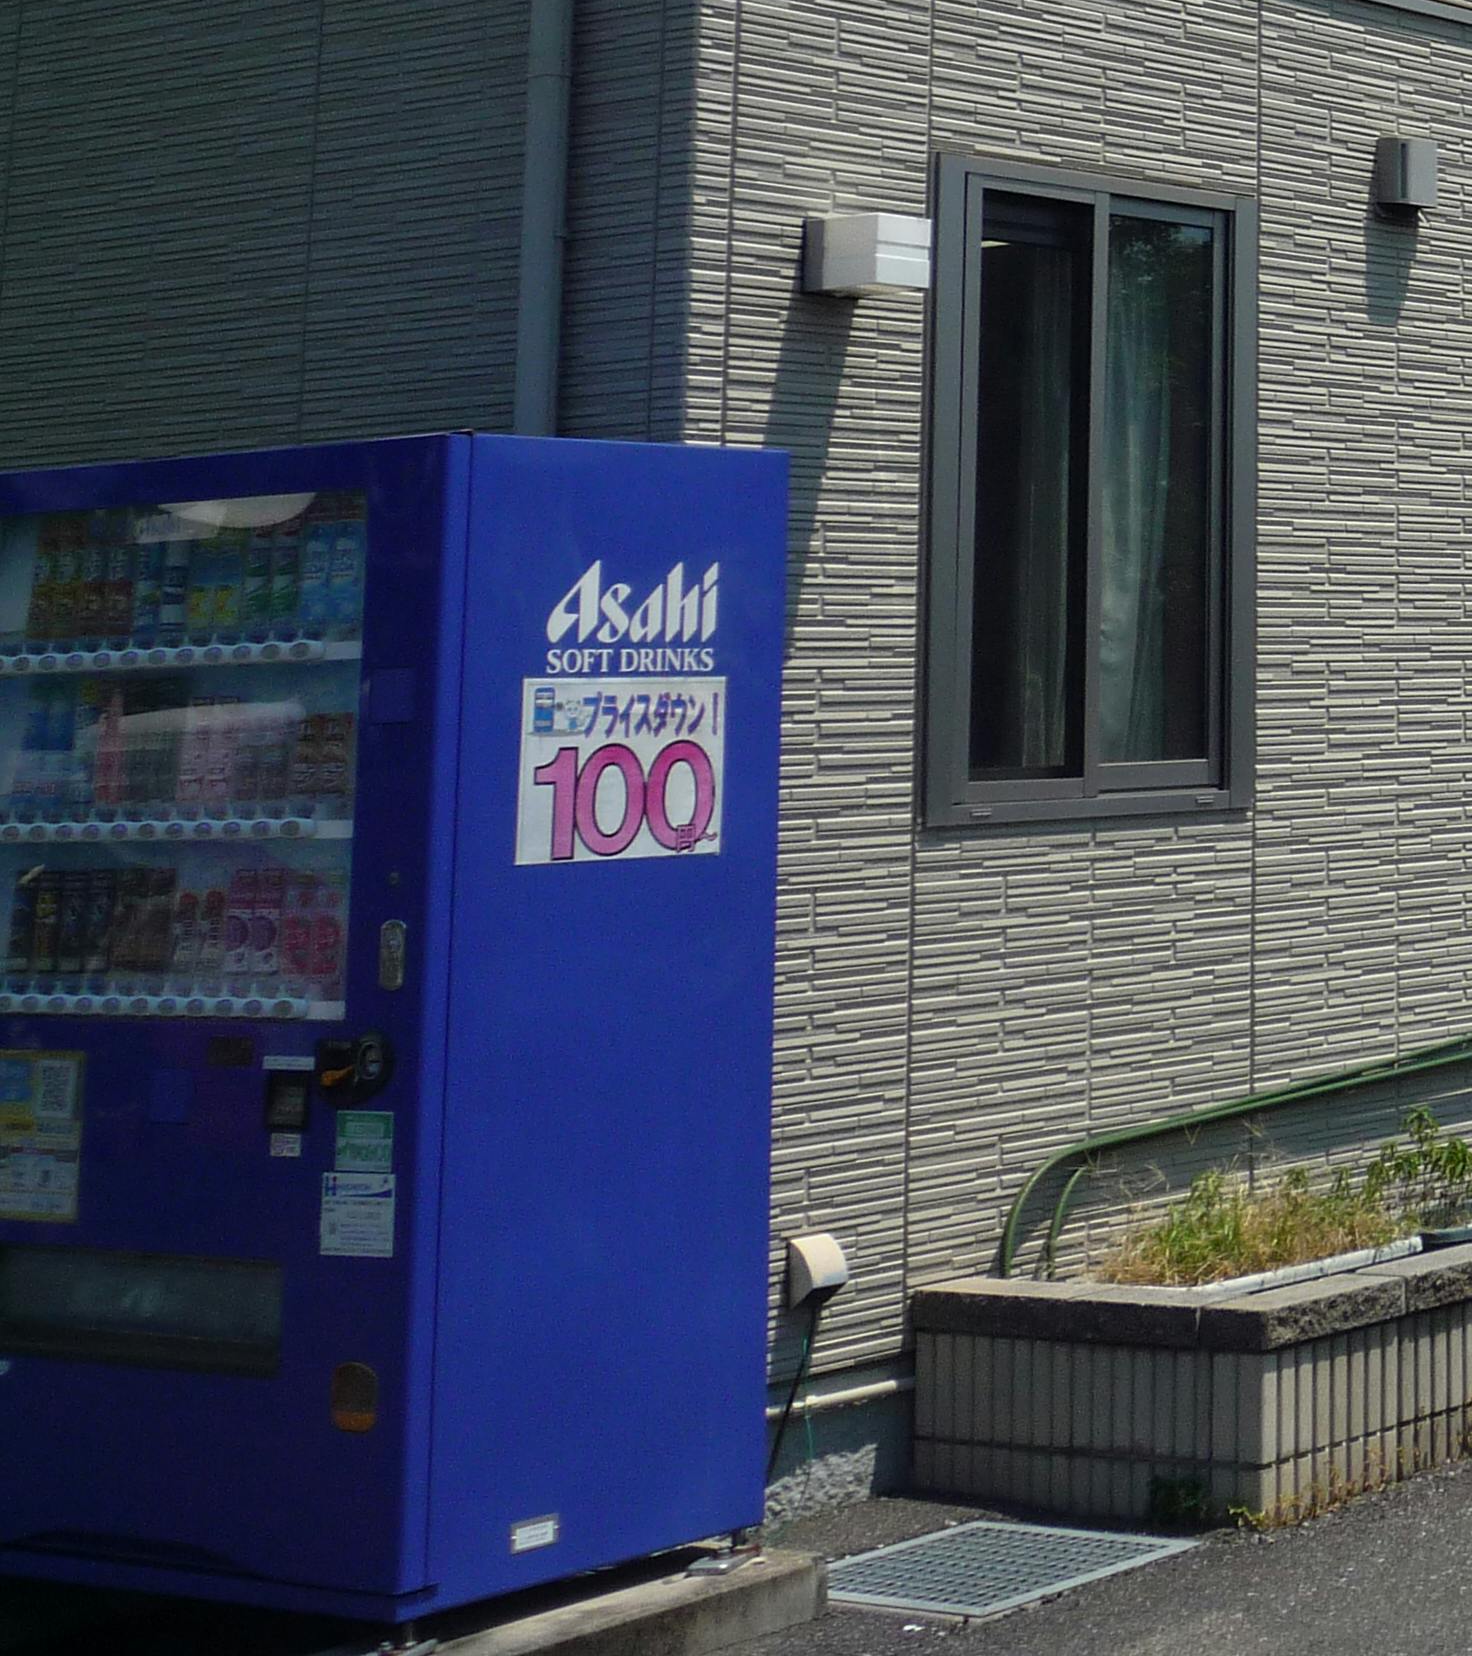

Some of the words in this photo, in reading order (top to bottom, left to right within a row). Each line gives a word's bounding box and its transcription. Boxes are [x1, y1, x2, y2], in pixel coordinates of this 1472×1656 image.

[546, 559, 719, 643] Asahi
[546, 649, 613, 674] SOFT
[620, 648, 714, 672] DRINKS
